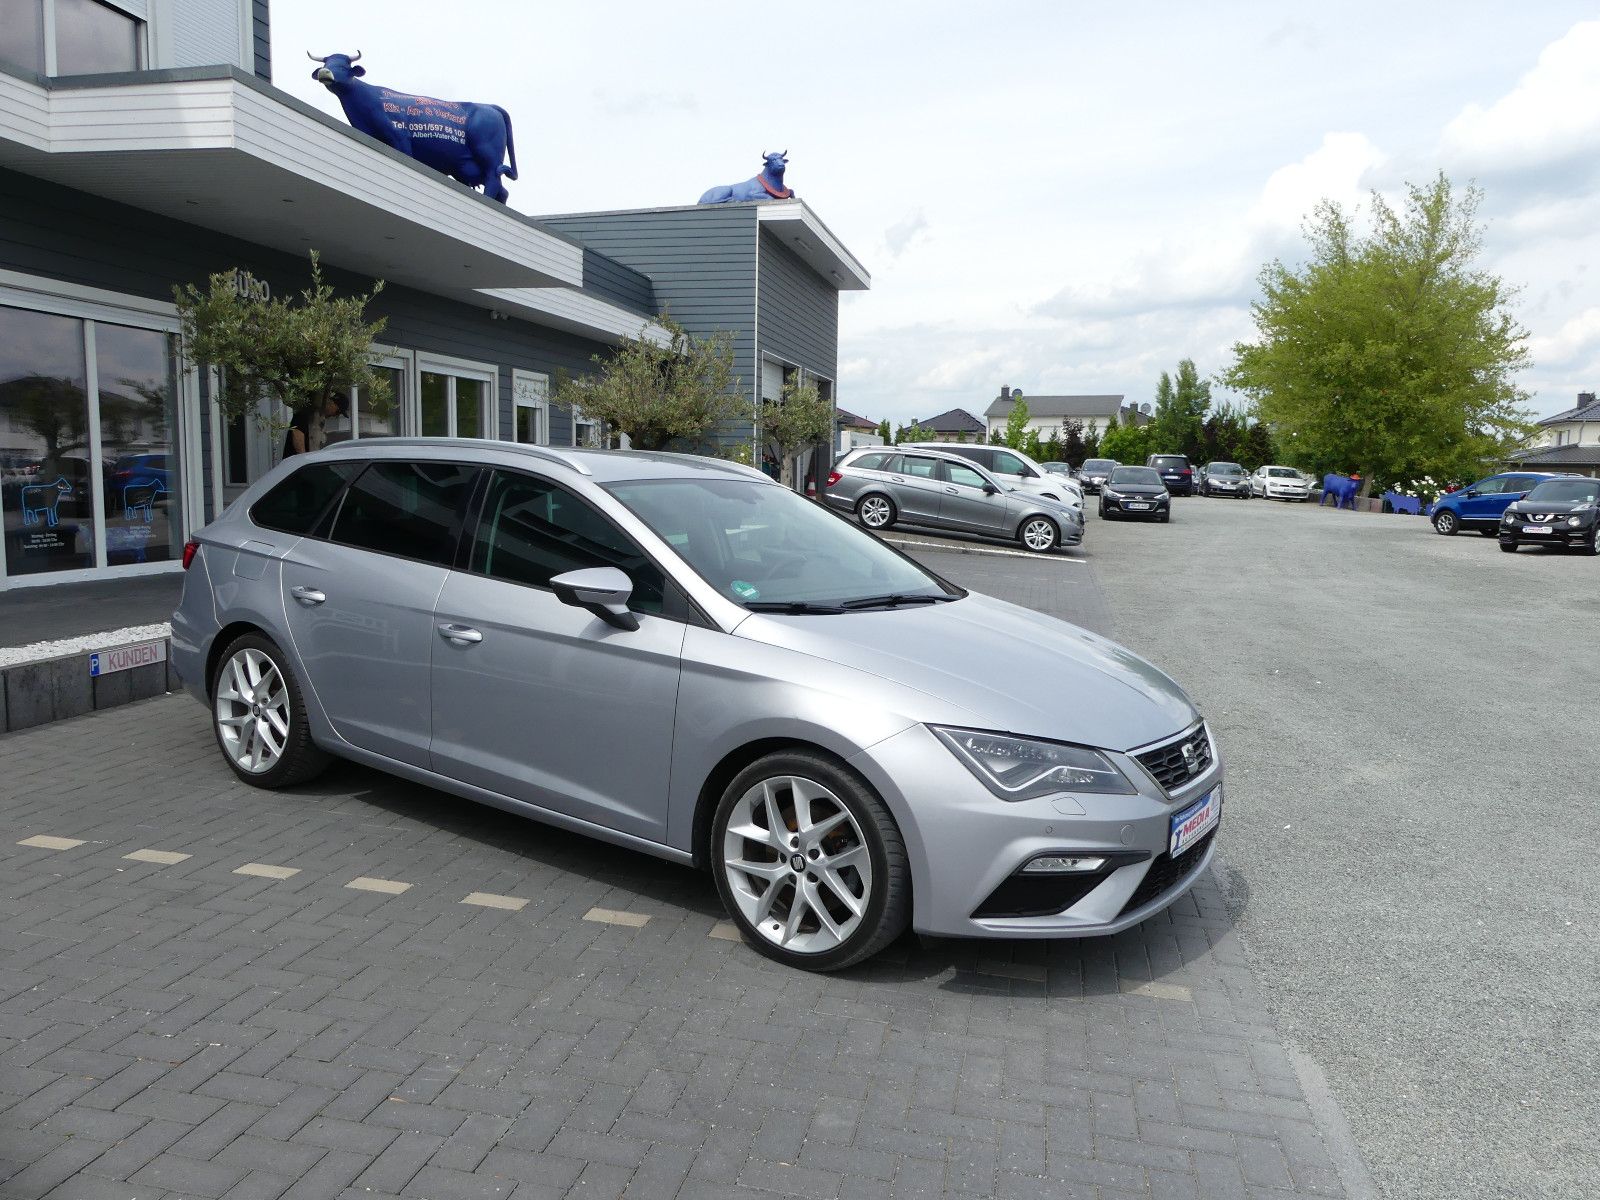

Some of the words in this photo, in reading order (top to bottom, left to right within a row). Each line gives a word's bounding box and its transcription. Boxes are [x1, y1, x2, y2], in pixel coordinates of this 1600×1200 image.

[392, 121, 407, 129] Tel.
[409, 123, 442, 131] 0391/597
[91, 659, 98, 671] P
[109, 646, 157, 670] KUNDEN
[1182, 806, 1210, 837] MEDIA
